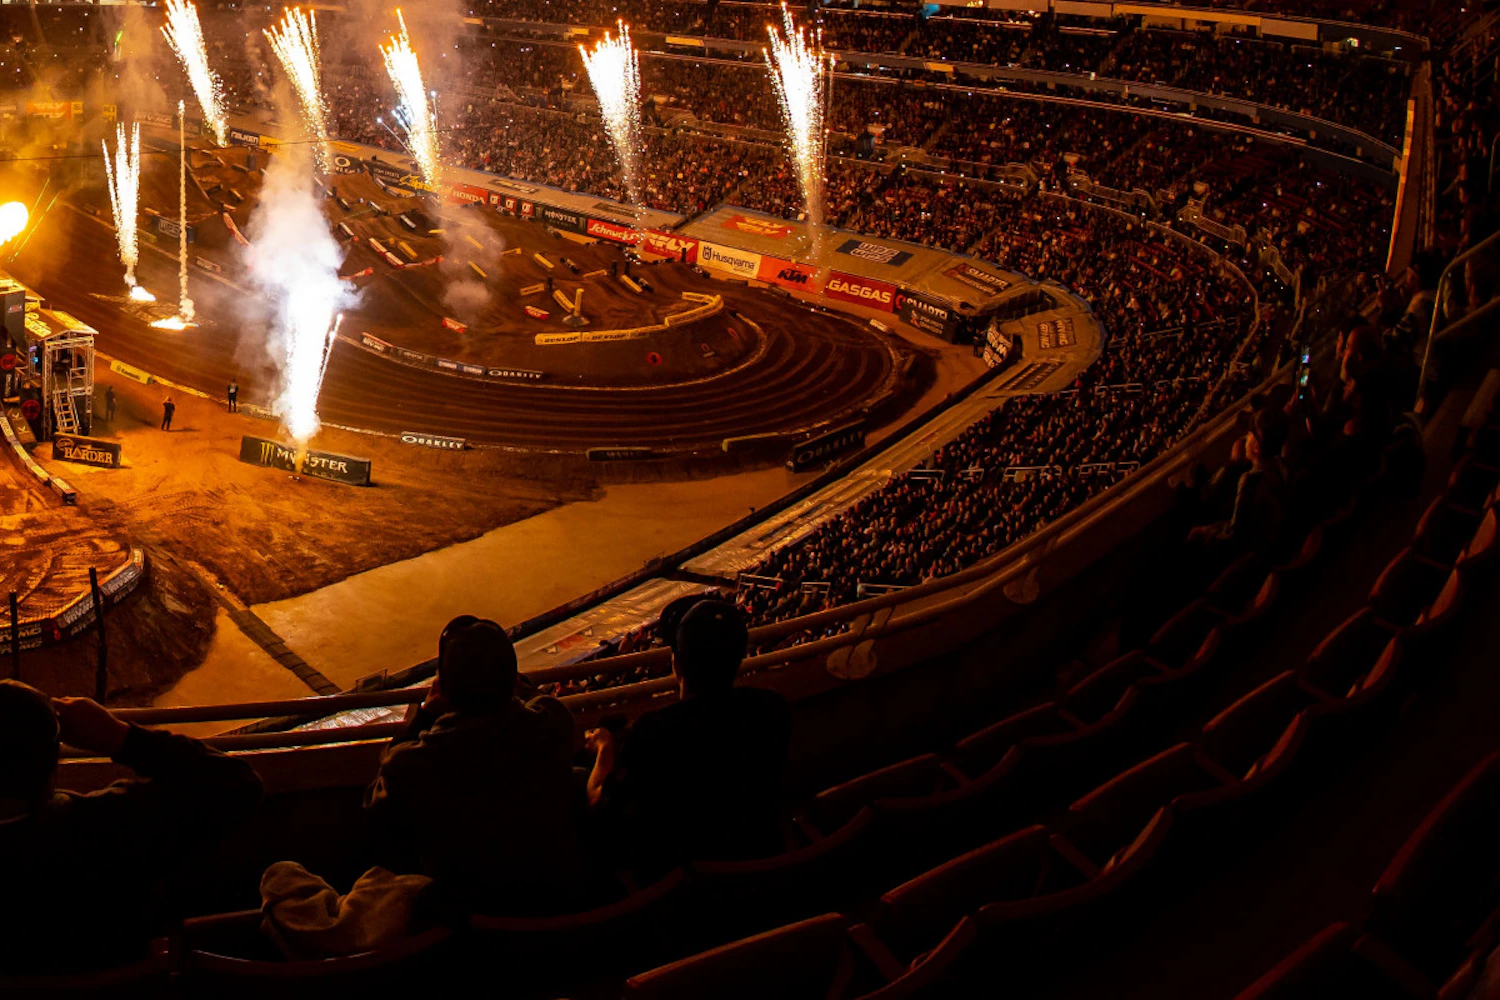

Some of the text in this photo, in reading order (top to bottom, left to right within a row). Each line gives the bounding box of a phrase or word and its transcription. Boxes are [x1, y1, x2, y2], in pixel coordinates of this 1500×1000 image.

[453, 191, 486, 204] HONDA
[545, 210, 578, 224] MONSTER
[588, 222, 639, 241] Schnucks
[712, 252, 755, 269] Husqvarna
[777, 269, 808, 284] KTM
[828, 280, 892, 304] GASGAS
[544, 335, 579, 343] DUNLOP
[592, 333, 626, 341] DUNLOP
[502, 370, 542, 379] OAKLEY
[417, 438, 463, 449] OAKLEY
[64, 447, 113, 465] HARDER
